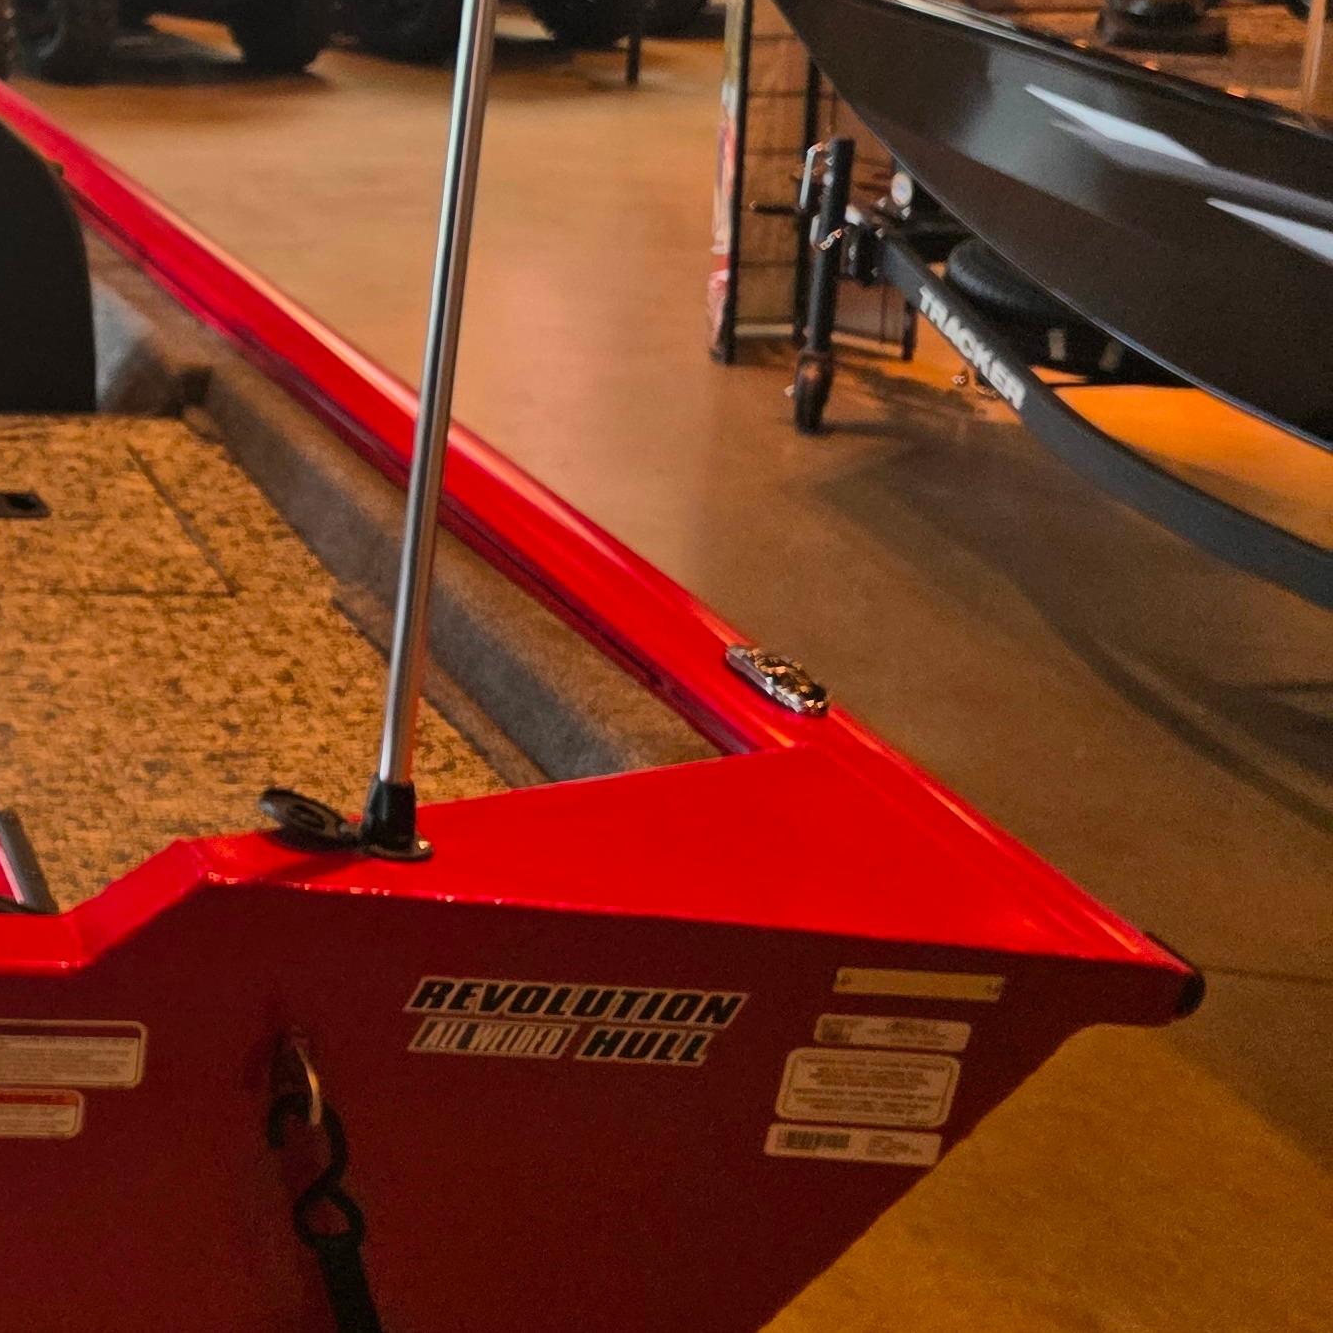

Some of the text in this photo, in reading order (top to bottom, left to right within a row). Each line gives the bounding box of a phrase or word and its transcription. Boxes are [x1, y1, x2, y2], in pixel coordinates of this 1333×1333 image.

[919, 283, 1026, 401] TRACKER
[410, 979, 742, 1026] REVOLUTION
[580, 1028, 709, 1062] HULL
